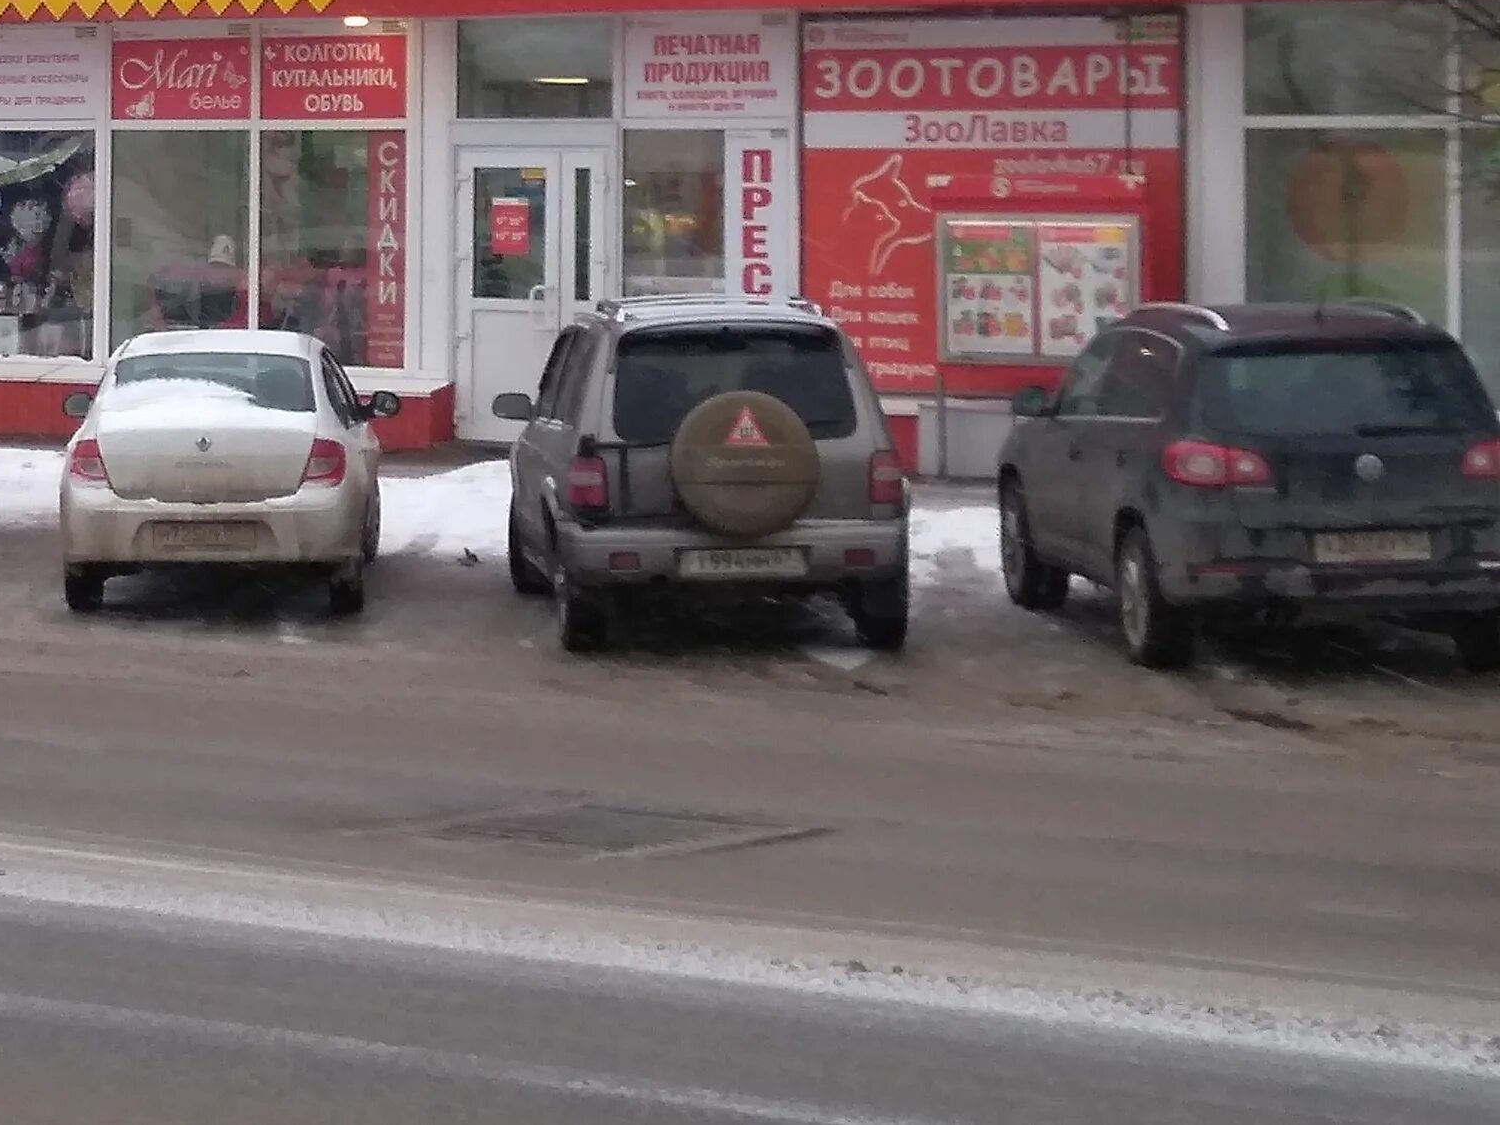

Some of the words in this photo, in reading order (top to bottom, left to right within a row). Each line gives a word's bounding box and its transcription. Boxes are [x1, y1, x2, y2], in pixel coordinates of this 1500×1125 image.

[284, 42, 385, 63] КОЛГОТКИ,
[654, 34, 761, 56] ПЕЧАТНАЯ
[120, 49, 222, 89] Mari
[272, 67, 398, 89] КУПАЛЬНИКИ,
[644, 61, 770, 84] ПРОДУКЦИЯ
[814, 54, 1170, 100] ЗООТОВАРЫ
[189, 92, 243, 110] белье
[304, 94, 364, 113] ОБУВЬ
[904, 114, 1069, 143] ЗооЛавка
[377, 141, 399, 305] СКИДКИ
[829, 281, 861, 297] Для
[868, 282, 914, 297] собак
[830, 306, 861, 323] Для
[870, 336, 910, 351] птиц
